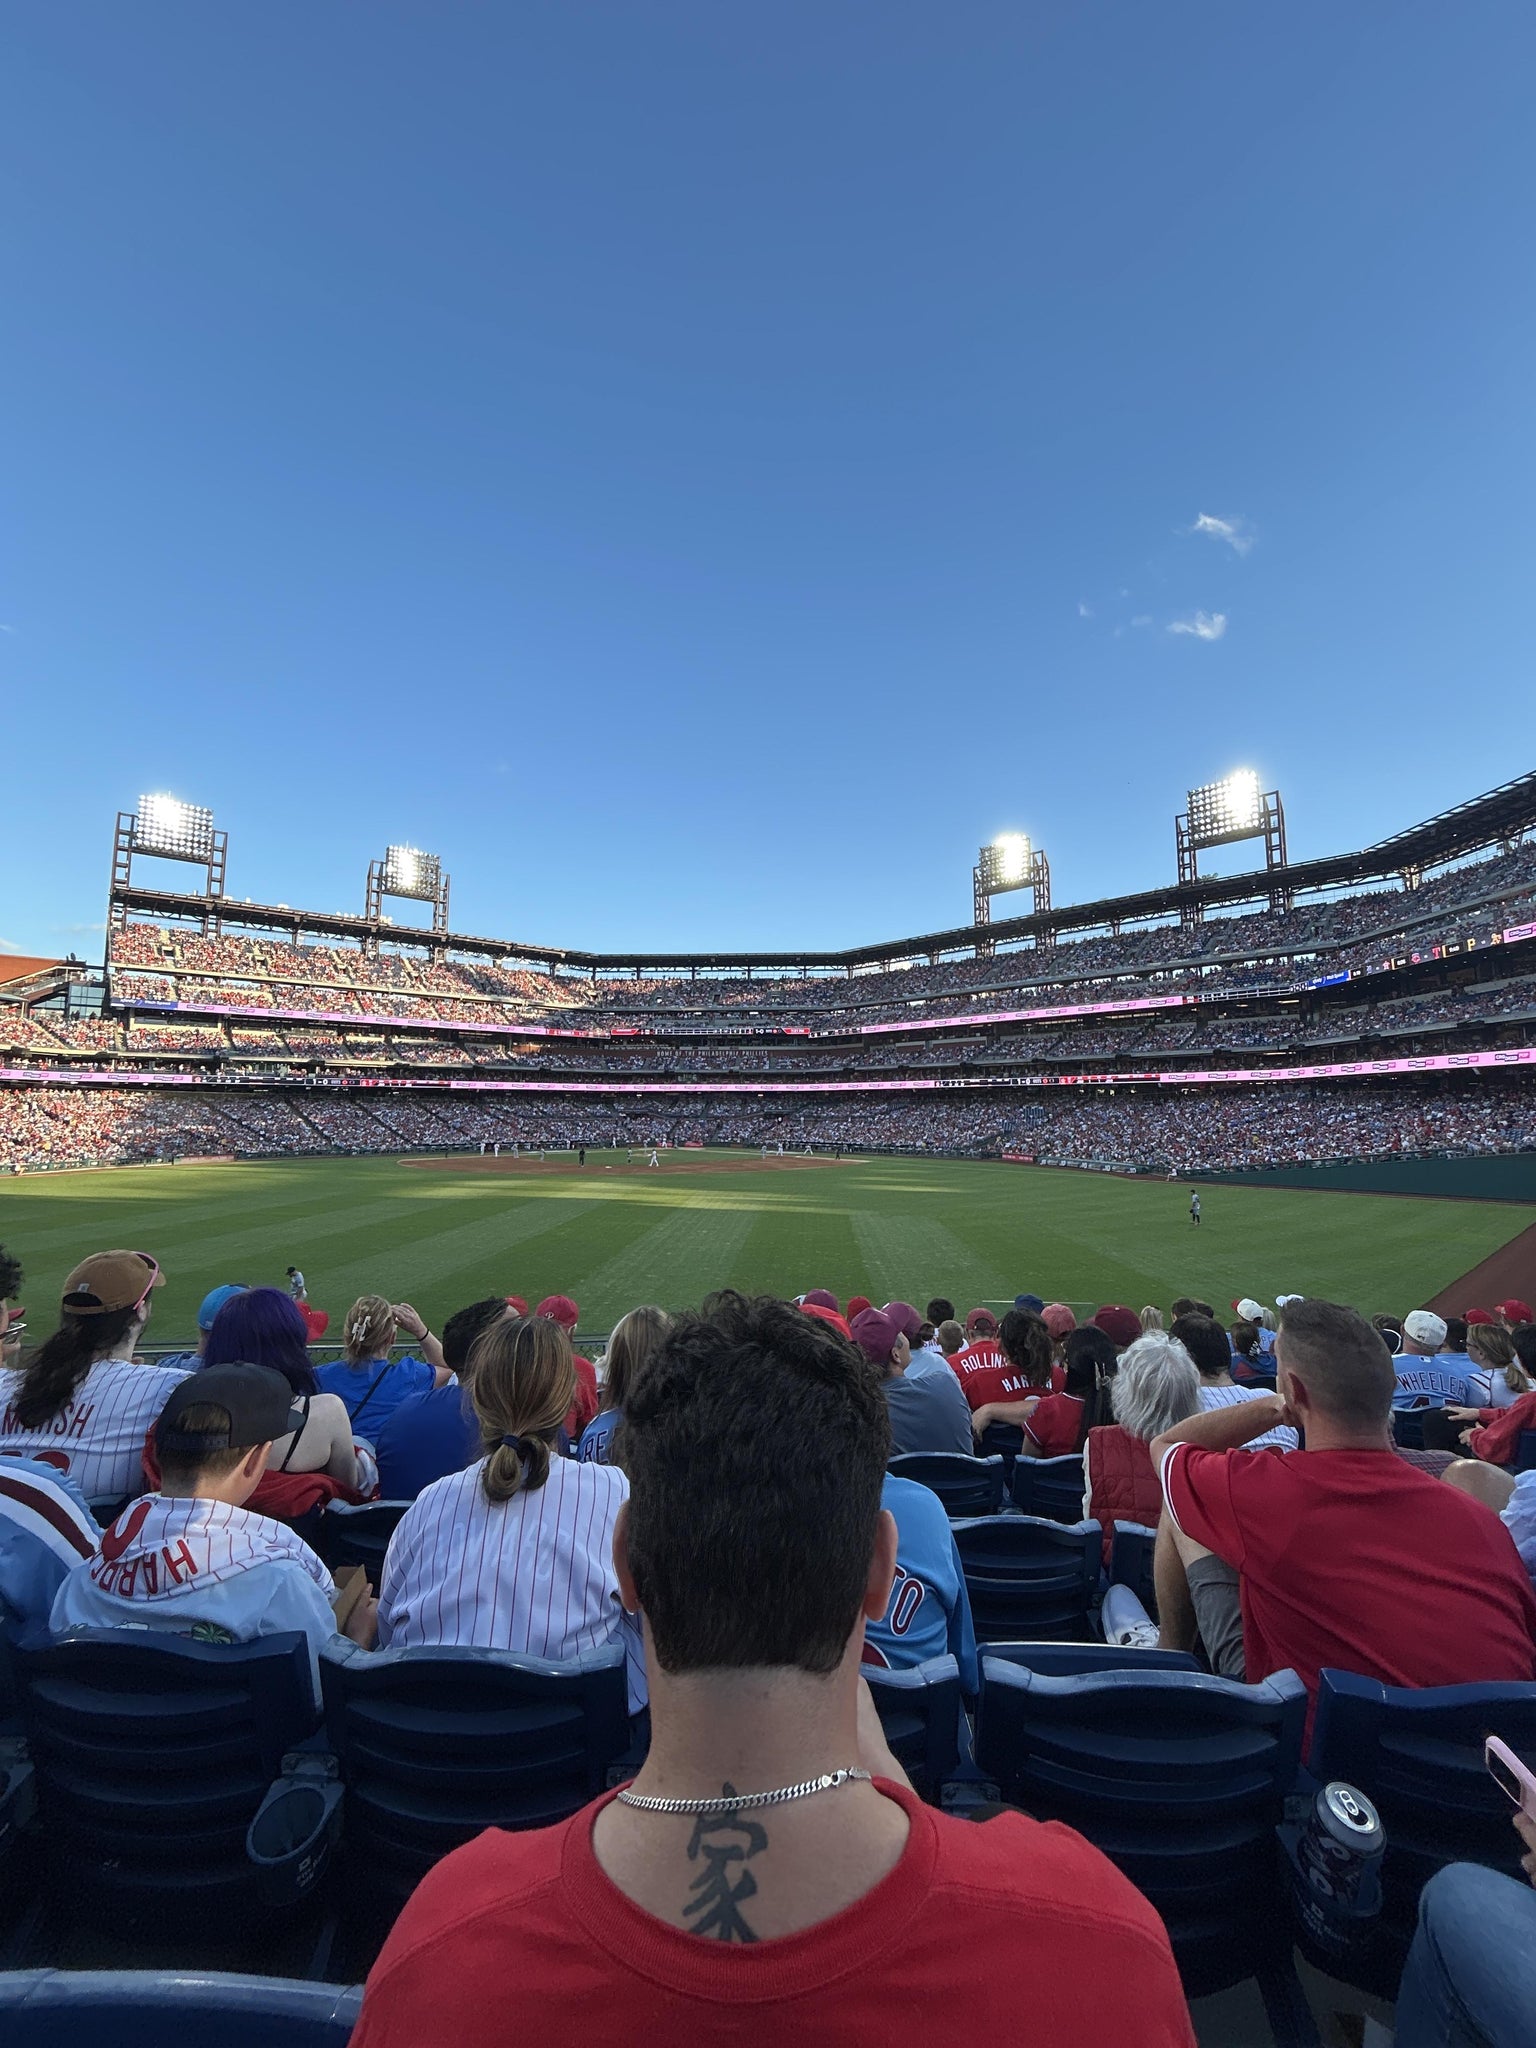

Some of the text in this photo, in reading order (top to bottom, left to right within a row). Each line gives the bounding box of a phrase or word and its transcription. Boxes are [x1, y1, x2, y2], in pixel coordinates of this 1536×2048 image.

[1432, 947, 1441, 960] T
[1466, 938, 1476, 951] P
[961, 1353, 1007, 1374] ROLLIN
[1396, 1371, 1465, 1398] WHEELER
[2, 1402, 95, 1438] MSH
[682, 1781, 768, 1943] 家
